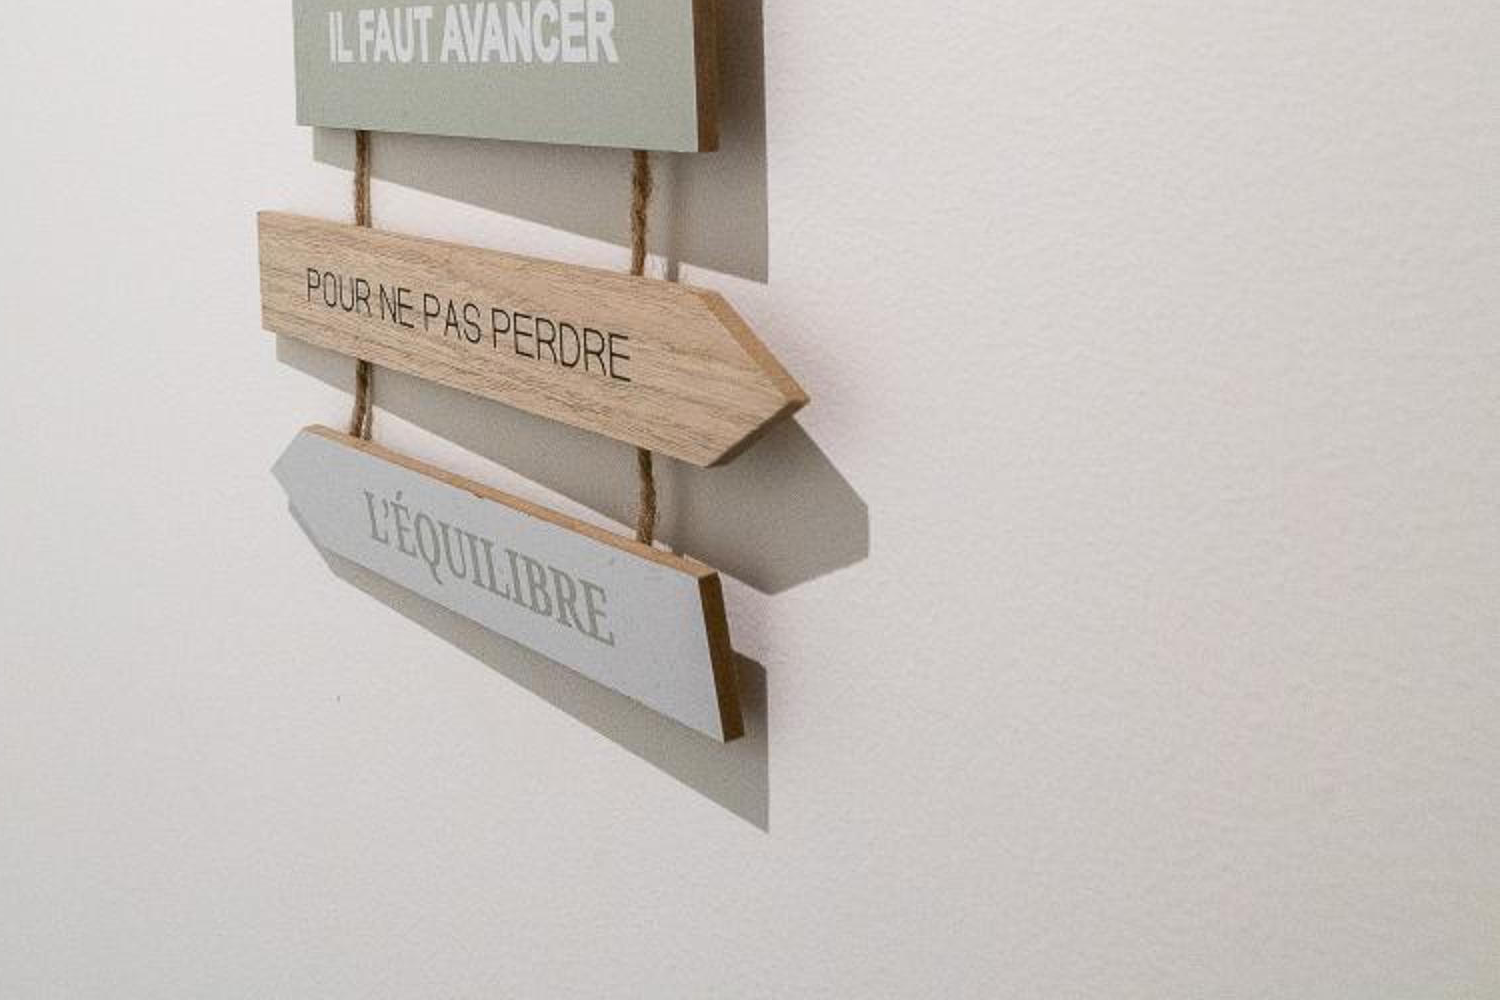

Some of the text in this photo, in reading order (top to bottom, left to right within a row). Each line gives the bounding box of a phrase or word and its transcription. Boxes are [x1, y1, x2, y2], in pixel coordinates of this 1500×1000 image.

[328, 11, 356, 64] IL
[358, 4, 433, 64] FAUT
[307, 267, 631, 382] POUR NE PAS PERDRE
[363, 490, 615, 648] L'ÉQUILIBRE
